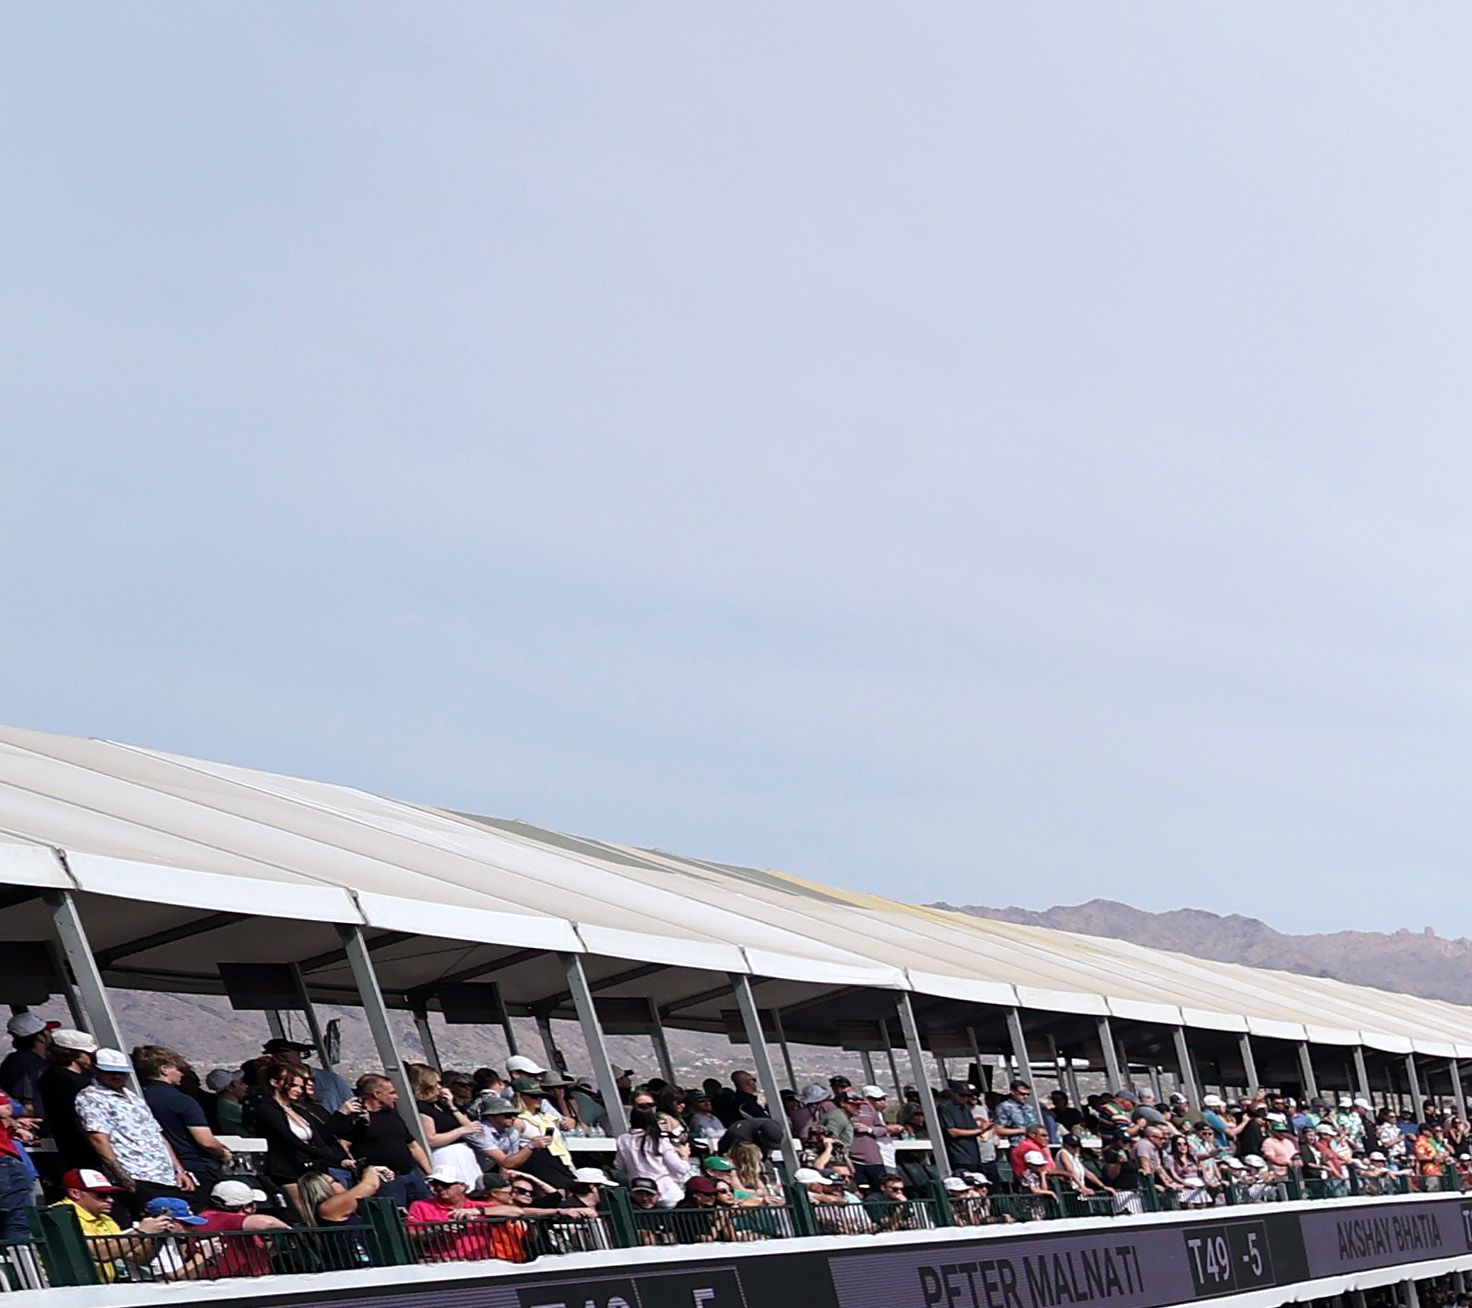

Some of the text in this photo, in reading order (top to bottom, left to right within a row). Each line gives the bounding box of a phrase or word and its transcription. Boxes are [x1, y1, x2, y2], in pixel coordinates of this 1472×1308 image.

[1336, 1215, 1393, 1260] AKSHAY
[1397, 1210, 1442, 1254] BHATIA
[1022, 1246, 1145, 1308] MALNATI
[1191, 1237, 1230, 1285] T49
[1242, 1232, 1263, 1276] -5
